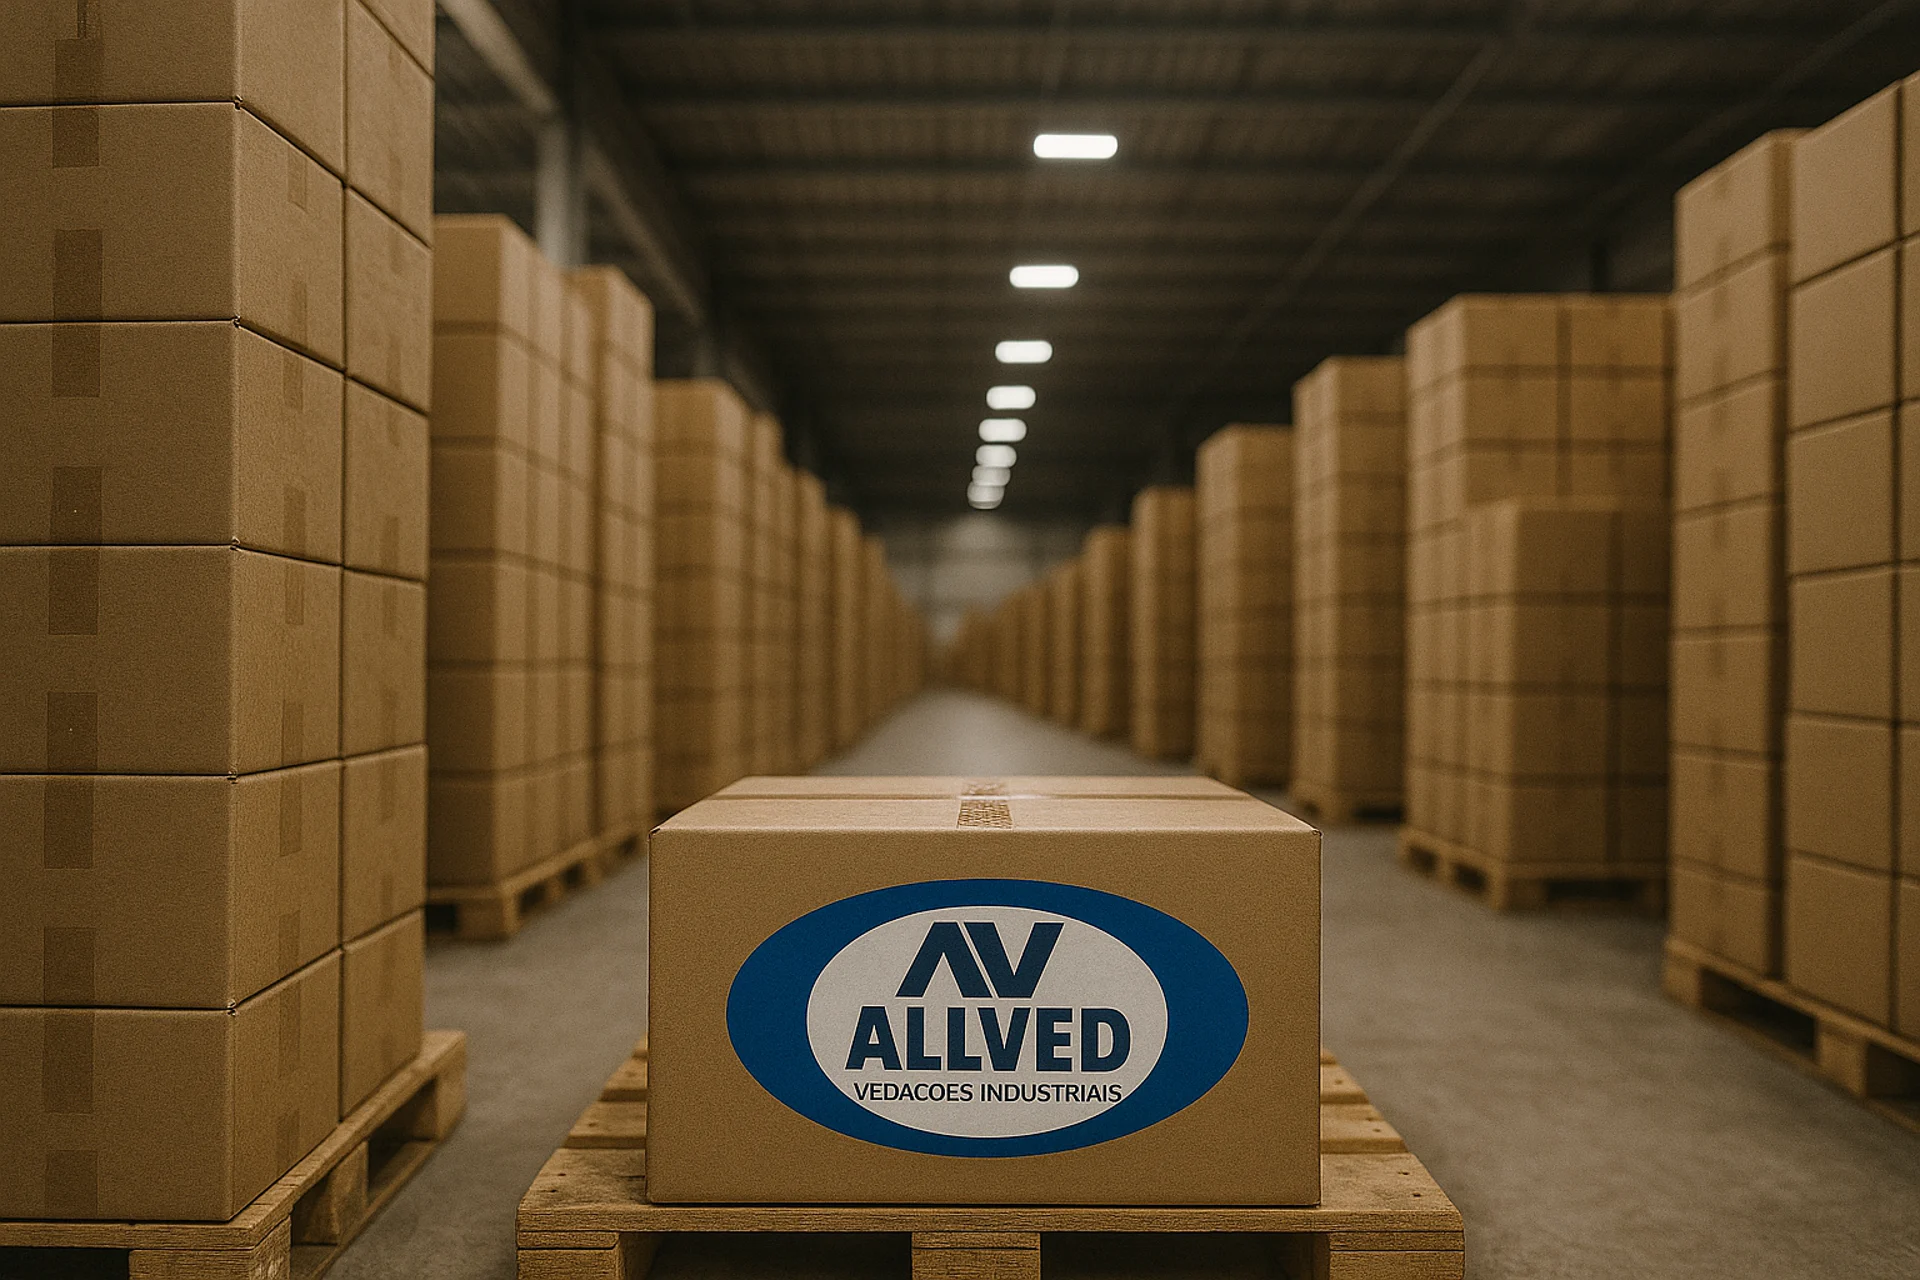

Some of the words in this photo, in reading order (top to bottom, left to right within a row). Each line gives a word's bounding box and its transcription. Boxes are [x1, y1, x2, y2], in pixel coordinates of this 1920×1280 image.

[895, 921, 1065, 999] AV
[844, 1005, 1132, 1073] ALLVED
[854, 1082, 973, 1102] VEDACOES
[980, 1083, 1122, 1103] INDUSTRIAIS
